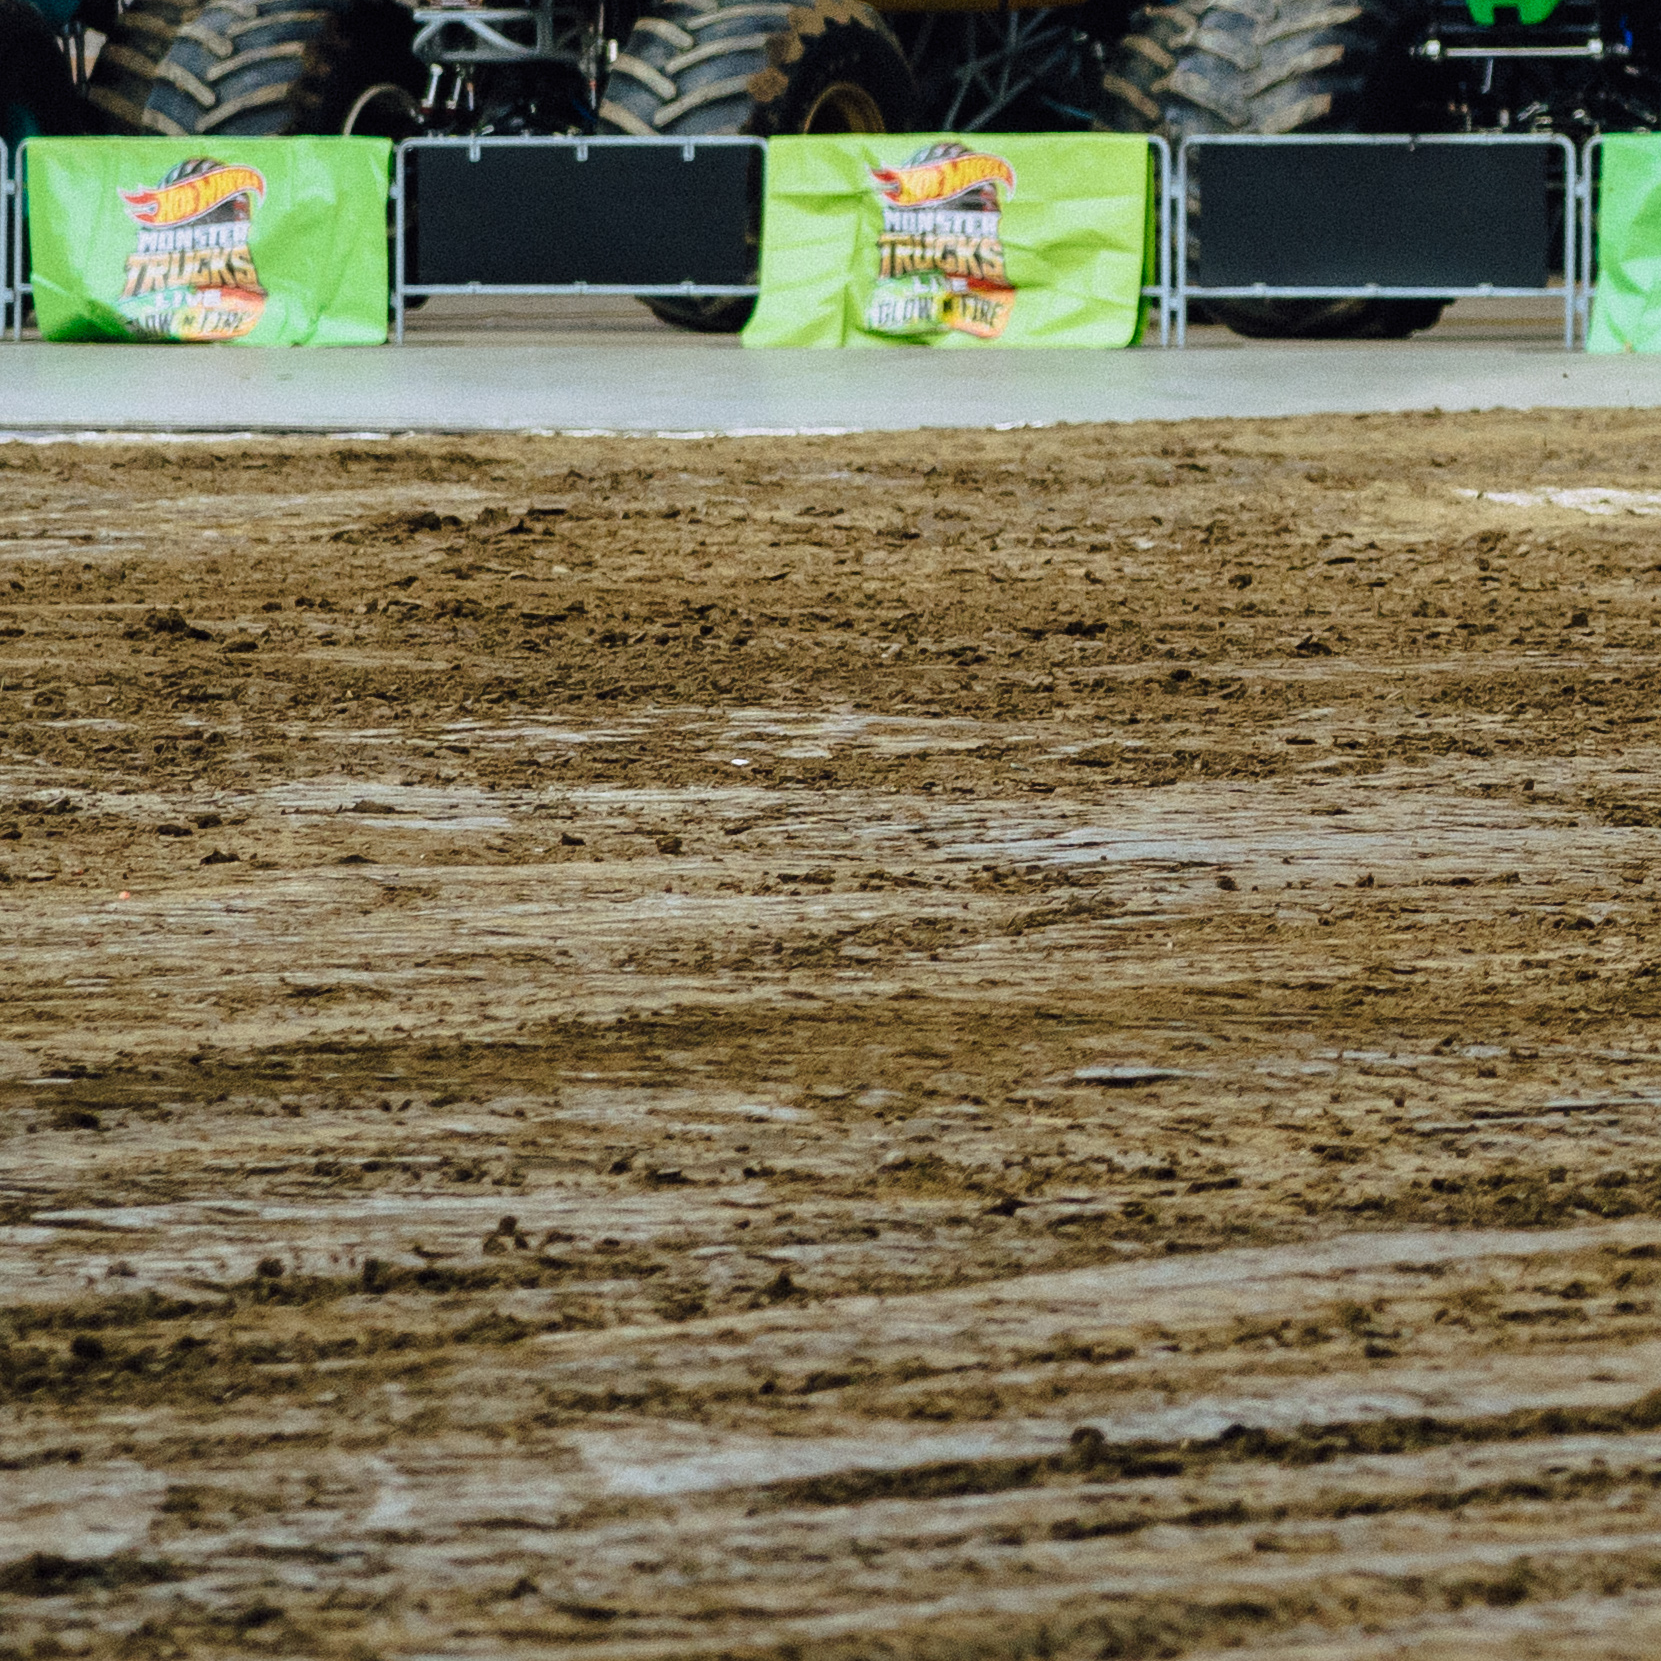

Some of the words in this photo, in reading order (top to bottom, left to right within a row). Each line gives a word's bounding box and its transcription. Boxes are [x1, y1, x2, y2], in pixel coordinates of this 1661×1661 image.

[137, 222, 250, 253] MONSTER
[883, 210, 1000, 235] MONSTER
[123, 246, 260, 297] TRUCKS
[878, 233, 1004, 279] TRUCKS
[154, 290, 222, 309] LIVE
